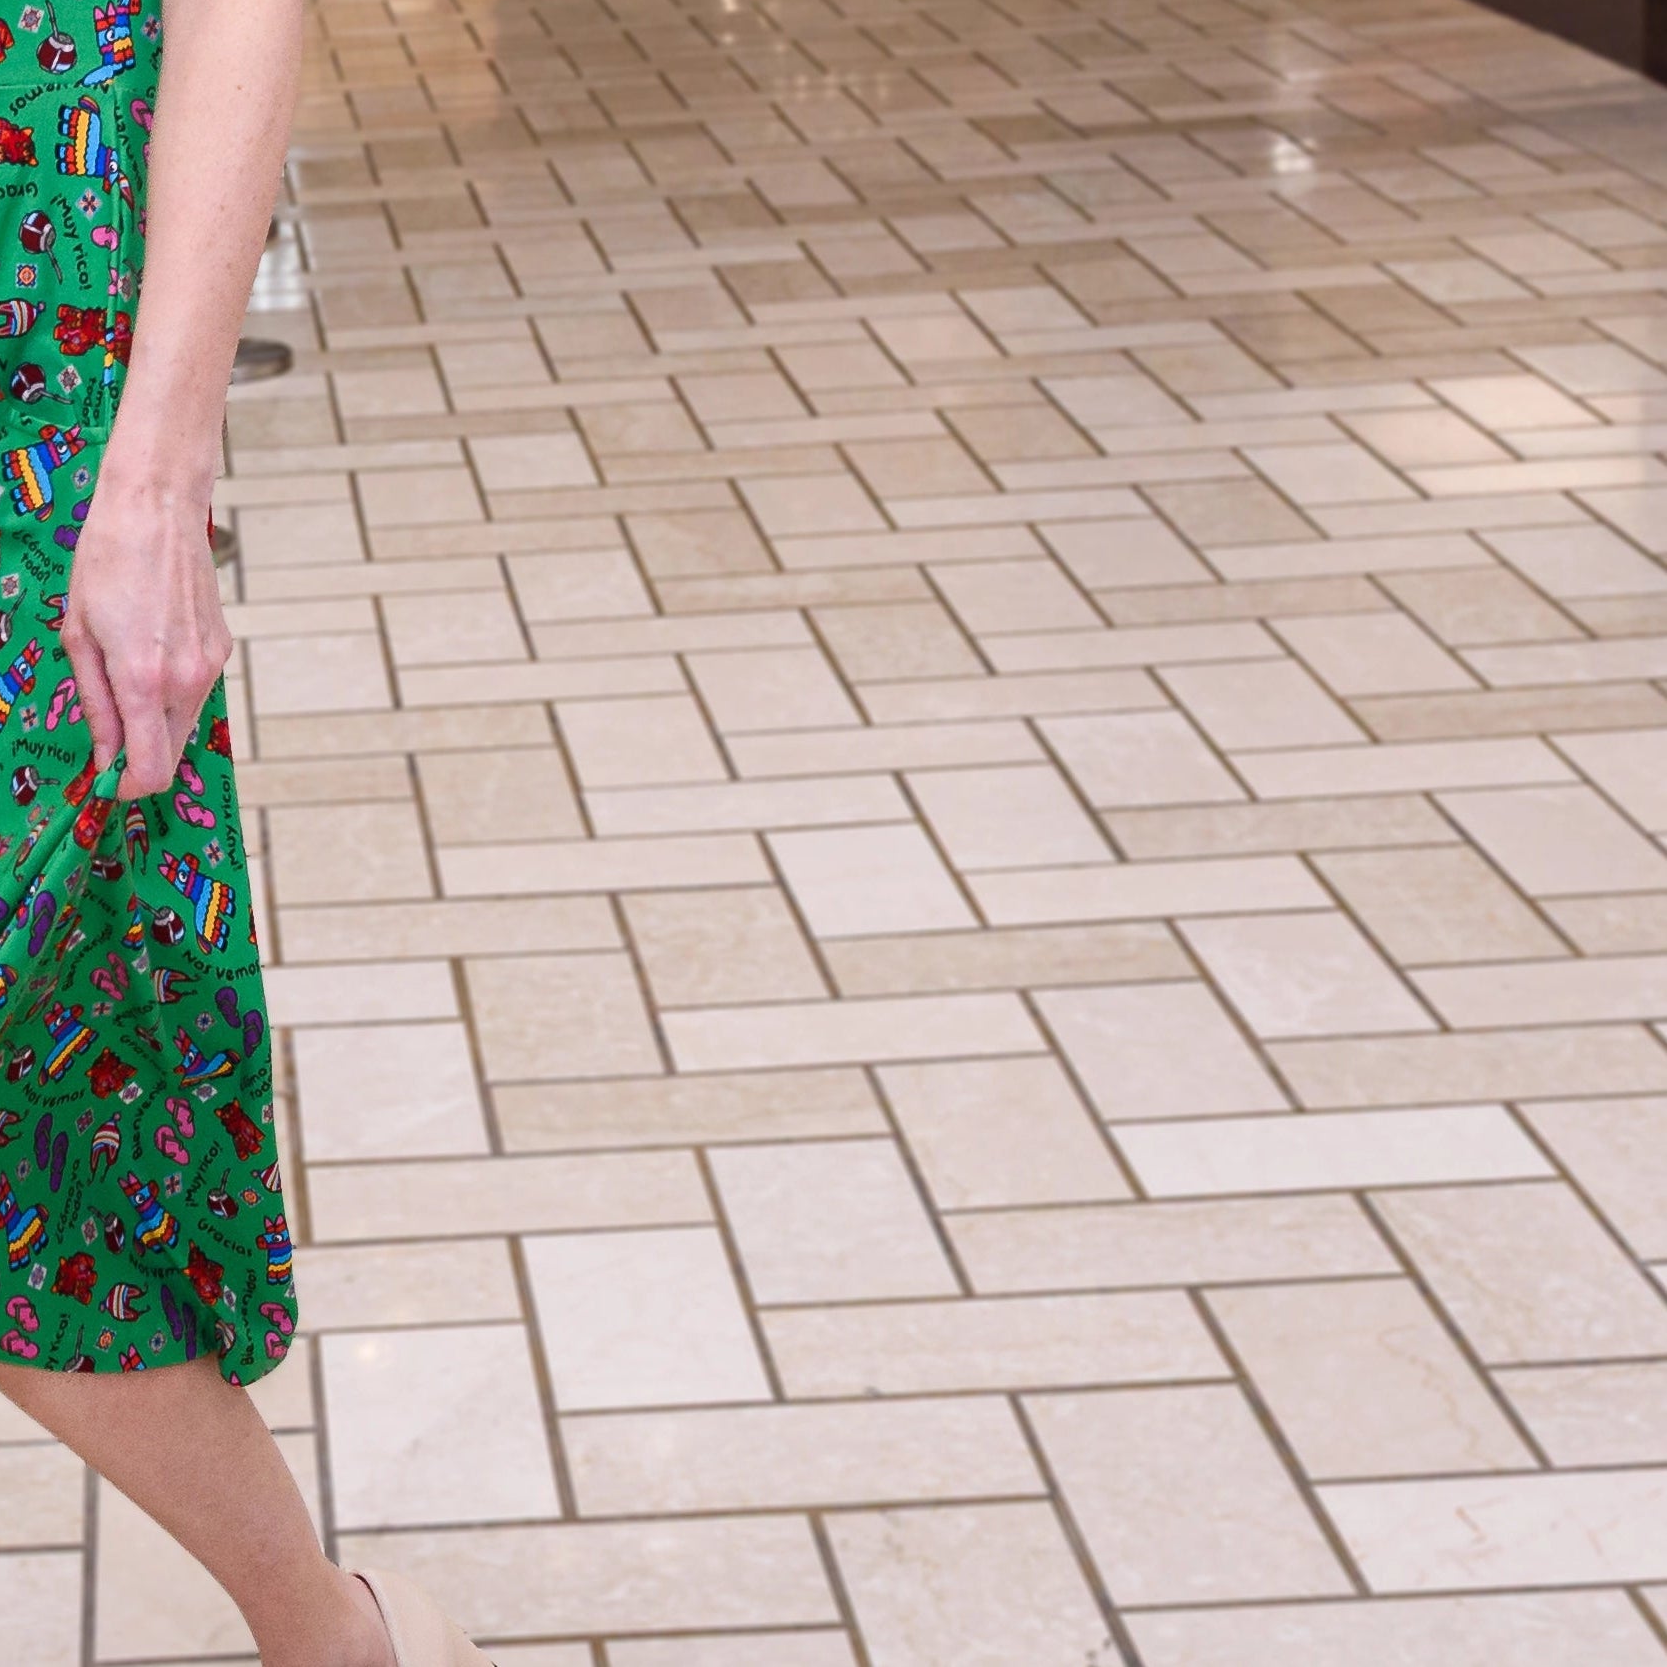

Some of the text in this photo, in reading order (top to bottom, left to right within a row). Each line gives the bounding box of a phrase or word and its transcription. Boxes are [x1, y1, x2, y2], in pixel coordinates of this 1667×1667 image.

[51, 195, 92, 290] ¡Muy rico!
[11, 738, 76, 767] ¡Muy rico!
[183, 949, 211, 975] Nos
[197, 1217, 253, 1258] Gracias
